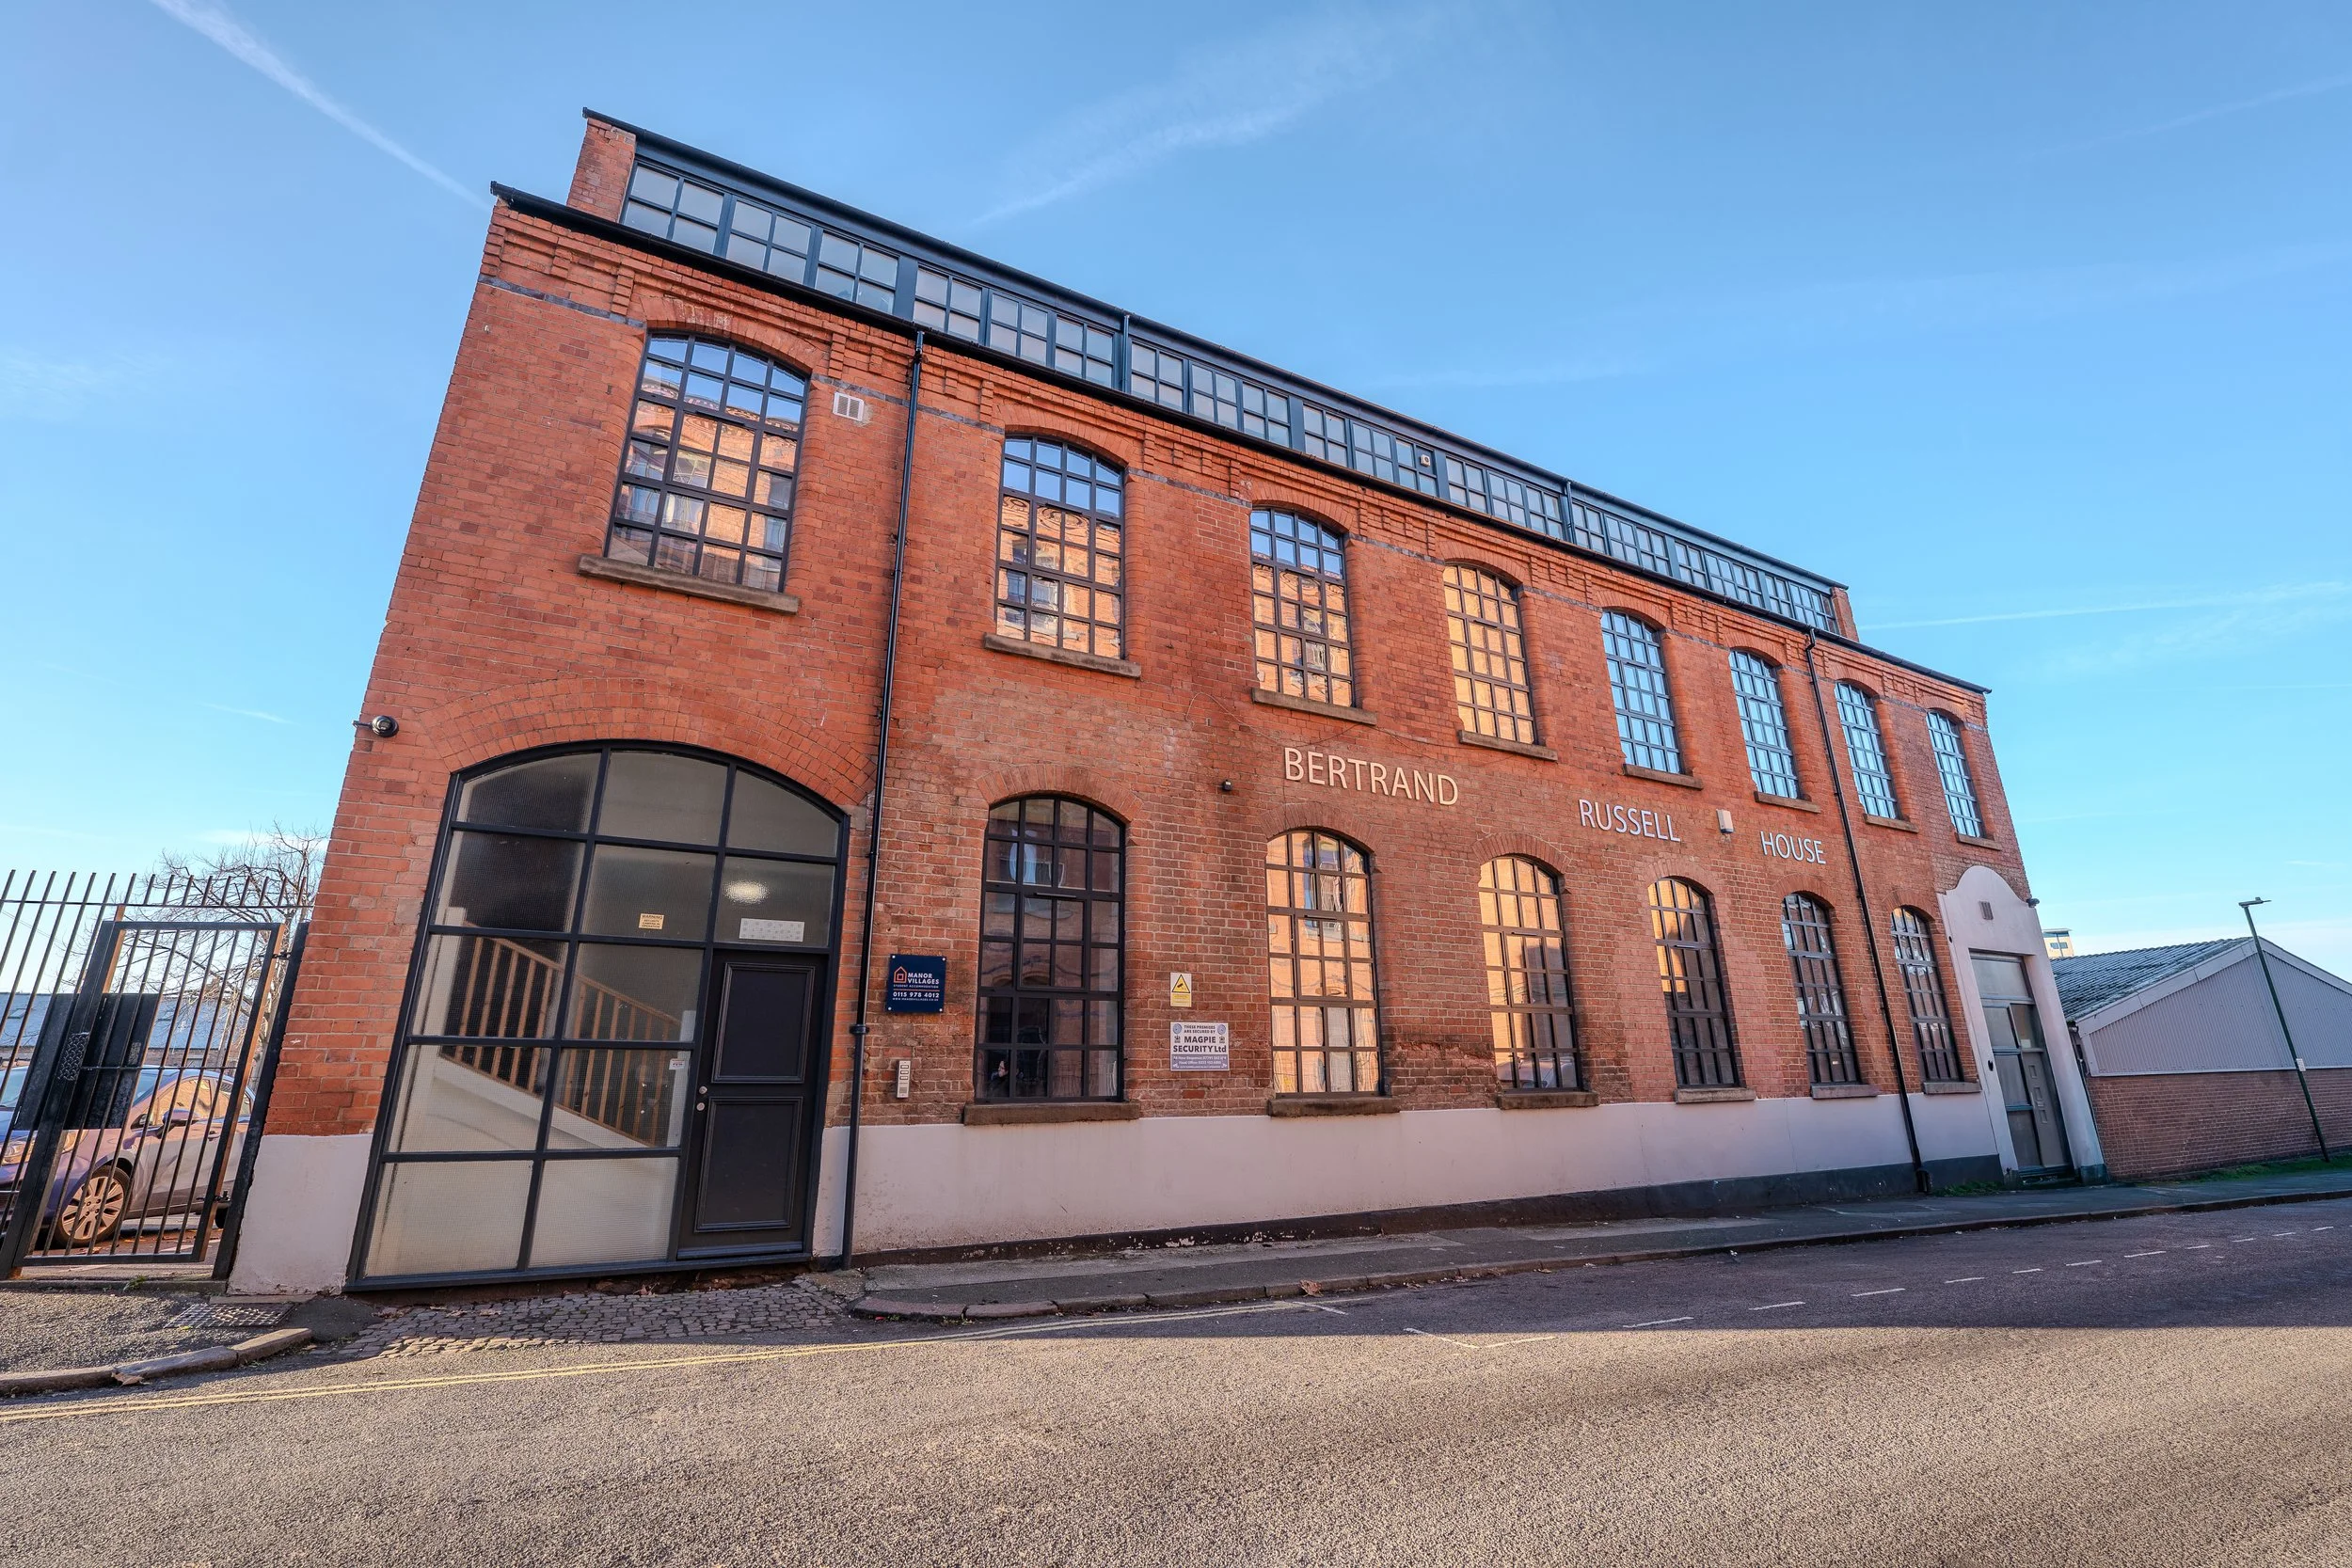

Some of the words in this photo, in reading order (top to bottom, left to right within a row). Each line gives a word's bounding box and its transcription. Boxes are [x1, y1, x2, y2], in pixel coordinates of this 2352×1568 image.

[1284, 747, 1458, 806] BERTRAND
[1579, 799, 1681, 843] RUSSELL
[1760, 831, 1827, 865] HOUSE
[1173, 1044, 1214, 1053] SECURITY
